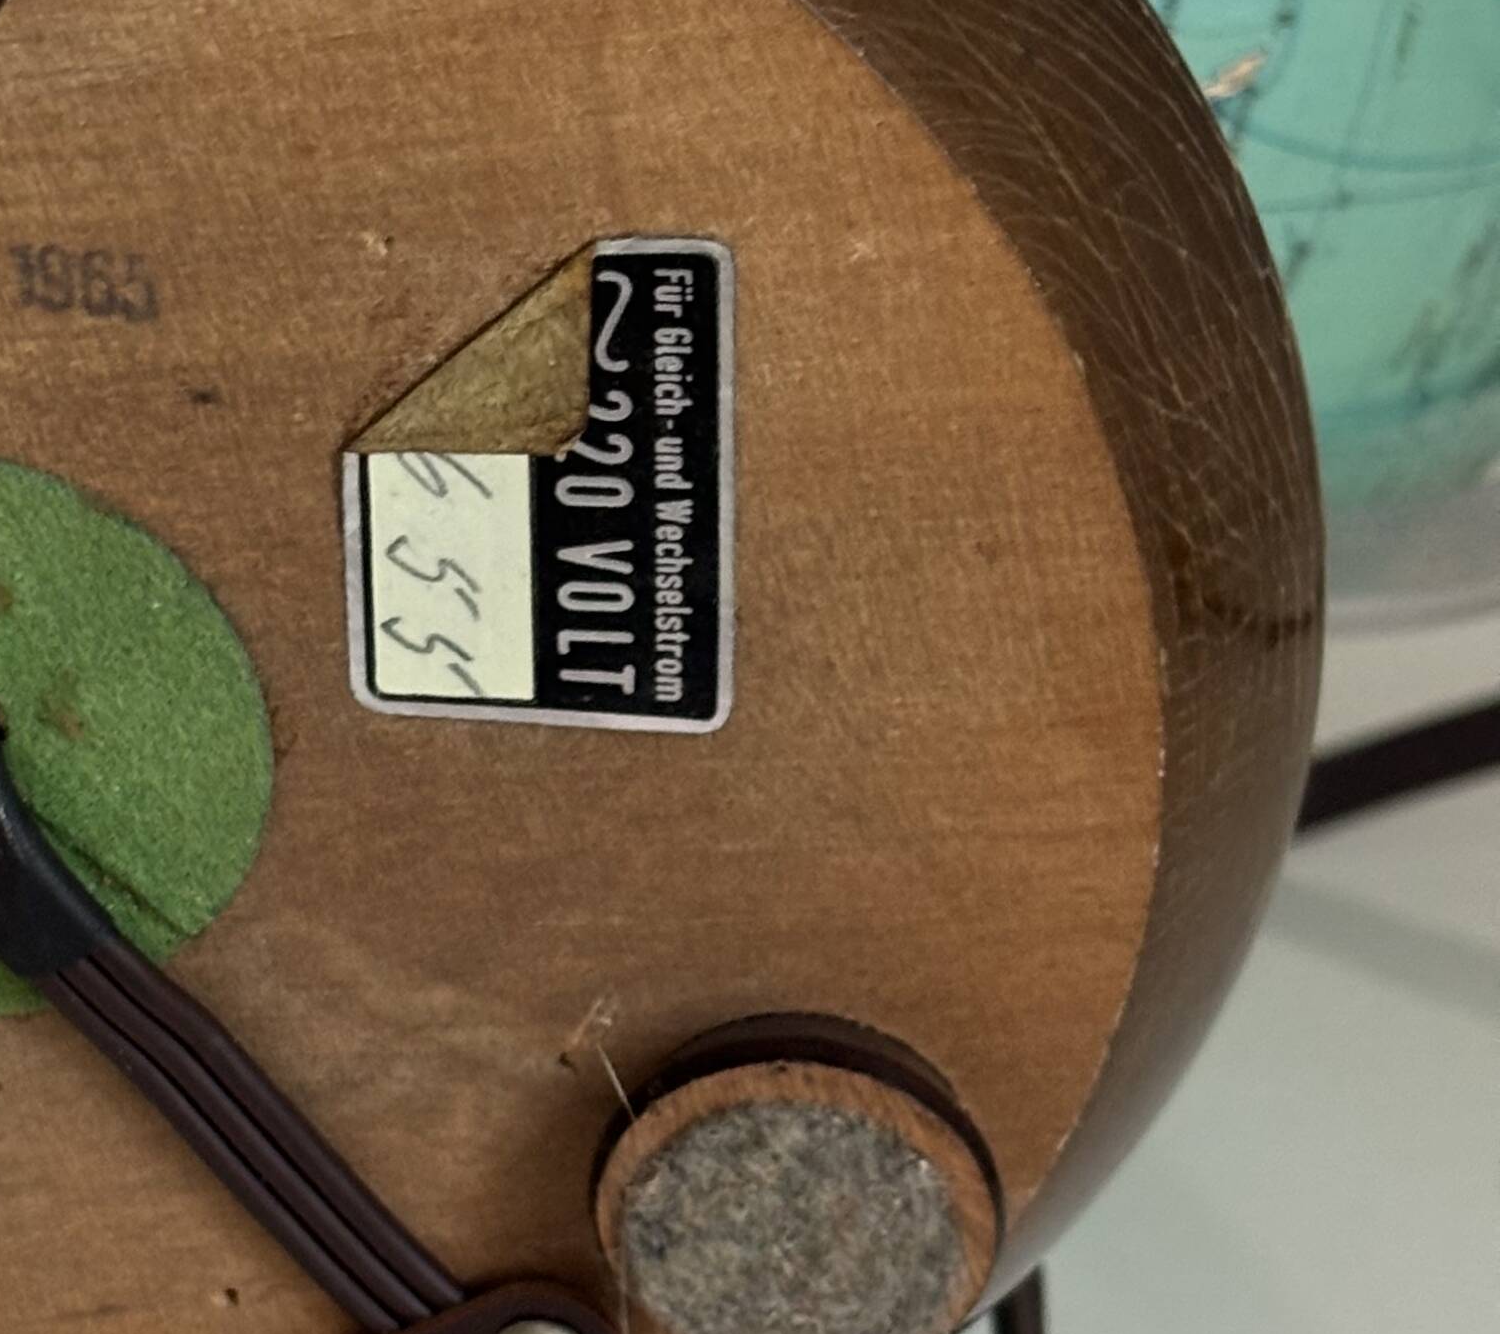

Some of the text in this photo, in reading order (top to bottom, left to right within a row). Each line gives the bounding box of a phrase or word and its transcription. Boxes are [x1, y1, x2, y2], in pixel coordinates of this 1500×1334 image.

[653, 269, 694, 315] Für
[653, 437, 694, 491] und
[556, 538, 636, 696] VOLT
[653, 498, 694, 704] Wechselstrom
